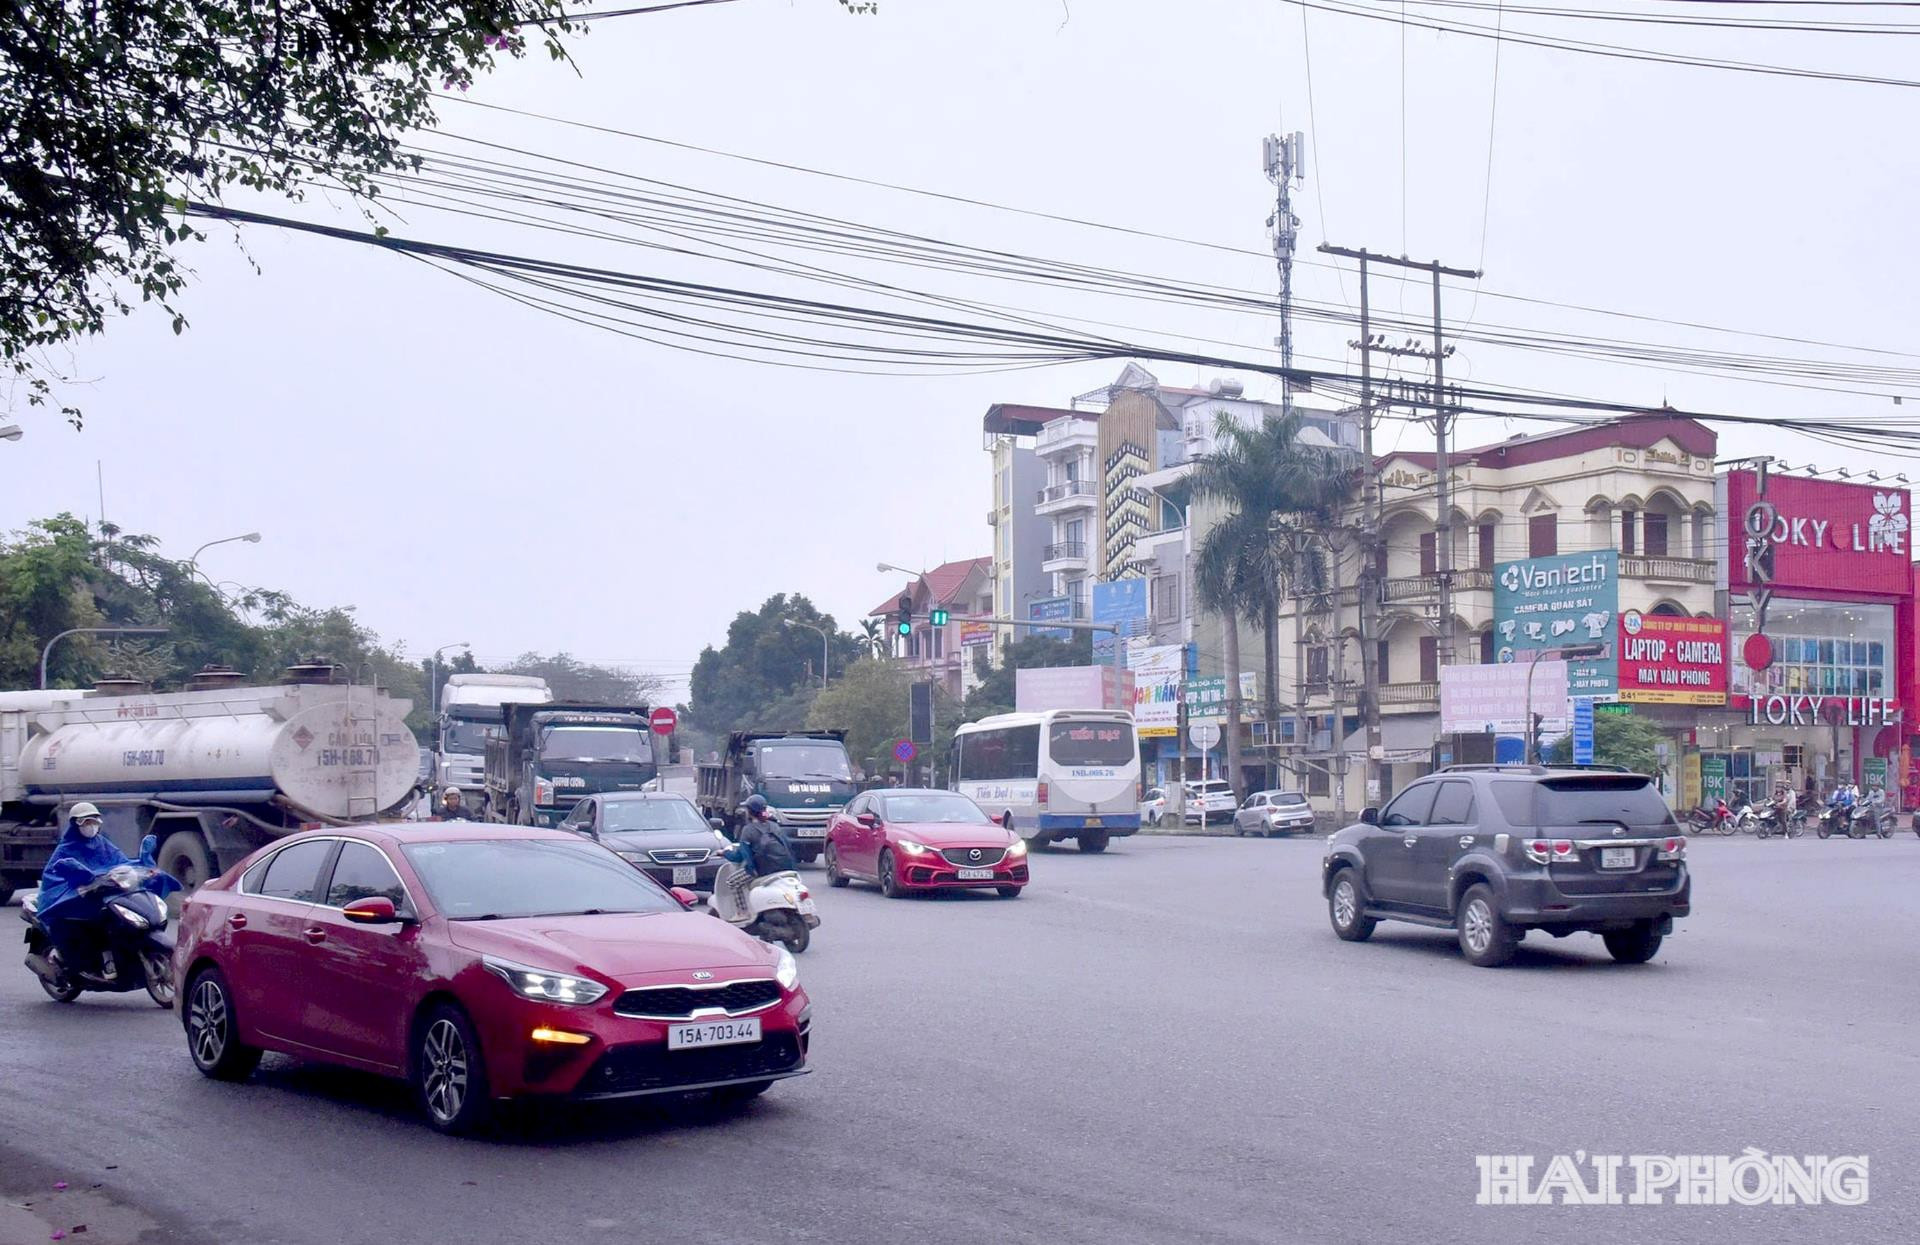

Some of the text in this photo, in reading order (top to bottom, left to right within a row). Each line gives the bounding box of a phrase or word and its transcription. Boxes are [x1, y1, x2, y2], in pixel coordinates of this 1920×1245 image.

[1520, 555, 1606, 588] Vantech
[1514, 603, 1549, 614] CAMERA
[1551, 600, 1574, 611] QUAN
[1624, 637, 1666, 662] LAPTOP
[1677, 640, 1722, 664] CAMERA
[1638, 666, 1658, 683] MÁY
[1621, 691, 1636, 699] 541
[1748, 695, 1895, 727] TOKY LIFE
[1703, 775, 1722, 788] 19K
[1865, 773, 1885, 787] 19K
[678, 1022, 754, 1044] 15A-703.44
